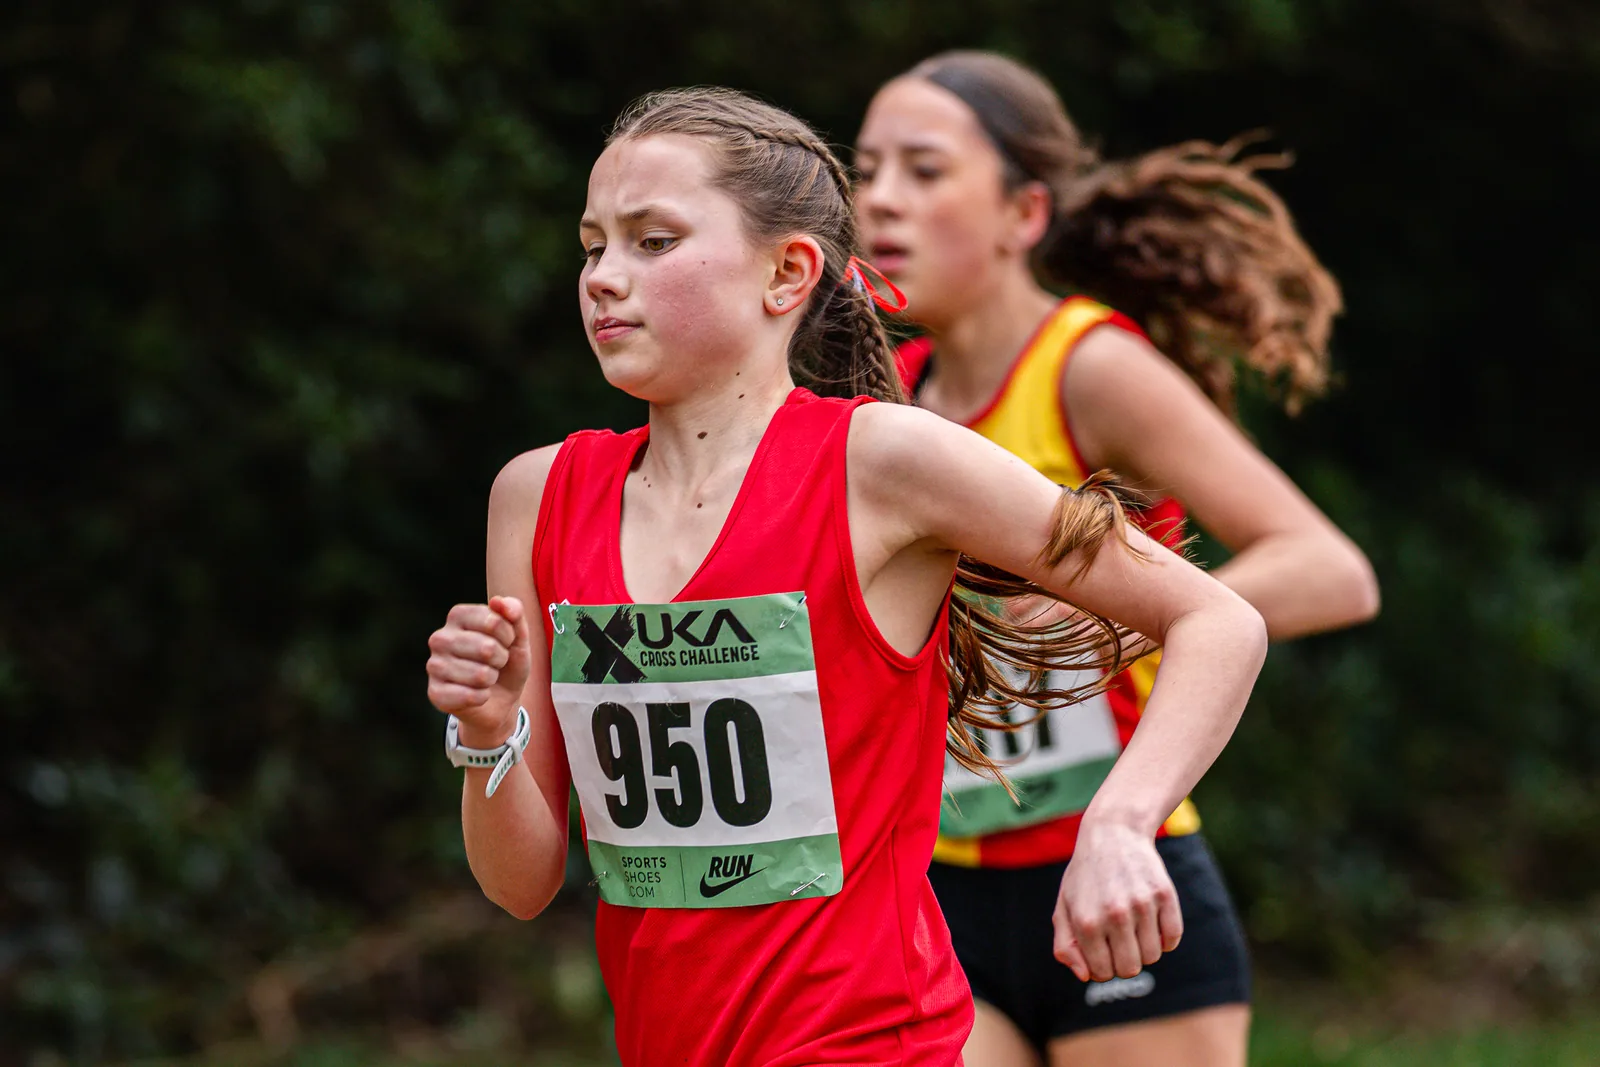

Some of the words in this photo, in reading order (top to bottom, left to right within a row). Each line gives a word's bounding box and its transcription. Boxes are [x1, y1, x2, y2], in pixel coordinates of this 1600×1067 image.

[636, 608, 757, 649] UKA
[640, 650, 677, 667] CROSS
[680, 644, 760, 666] CHALLENGE
[591, 697, 772, 829] 950
[621, 856, 667, 869] SPORTS
[708, 854, 753, 878] RUN
[624, 871, 661, 883] SHOES
